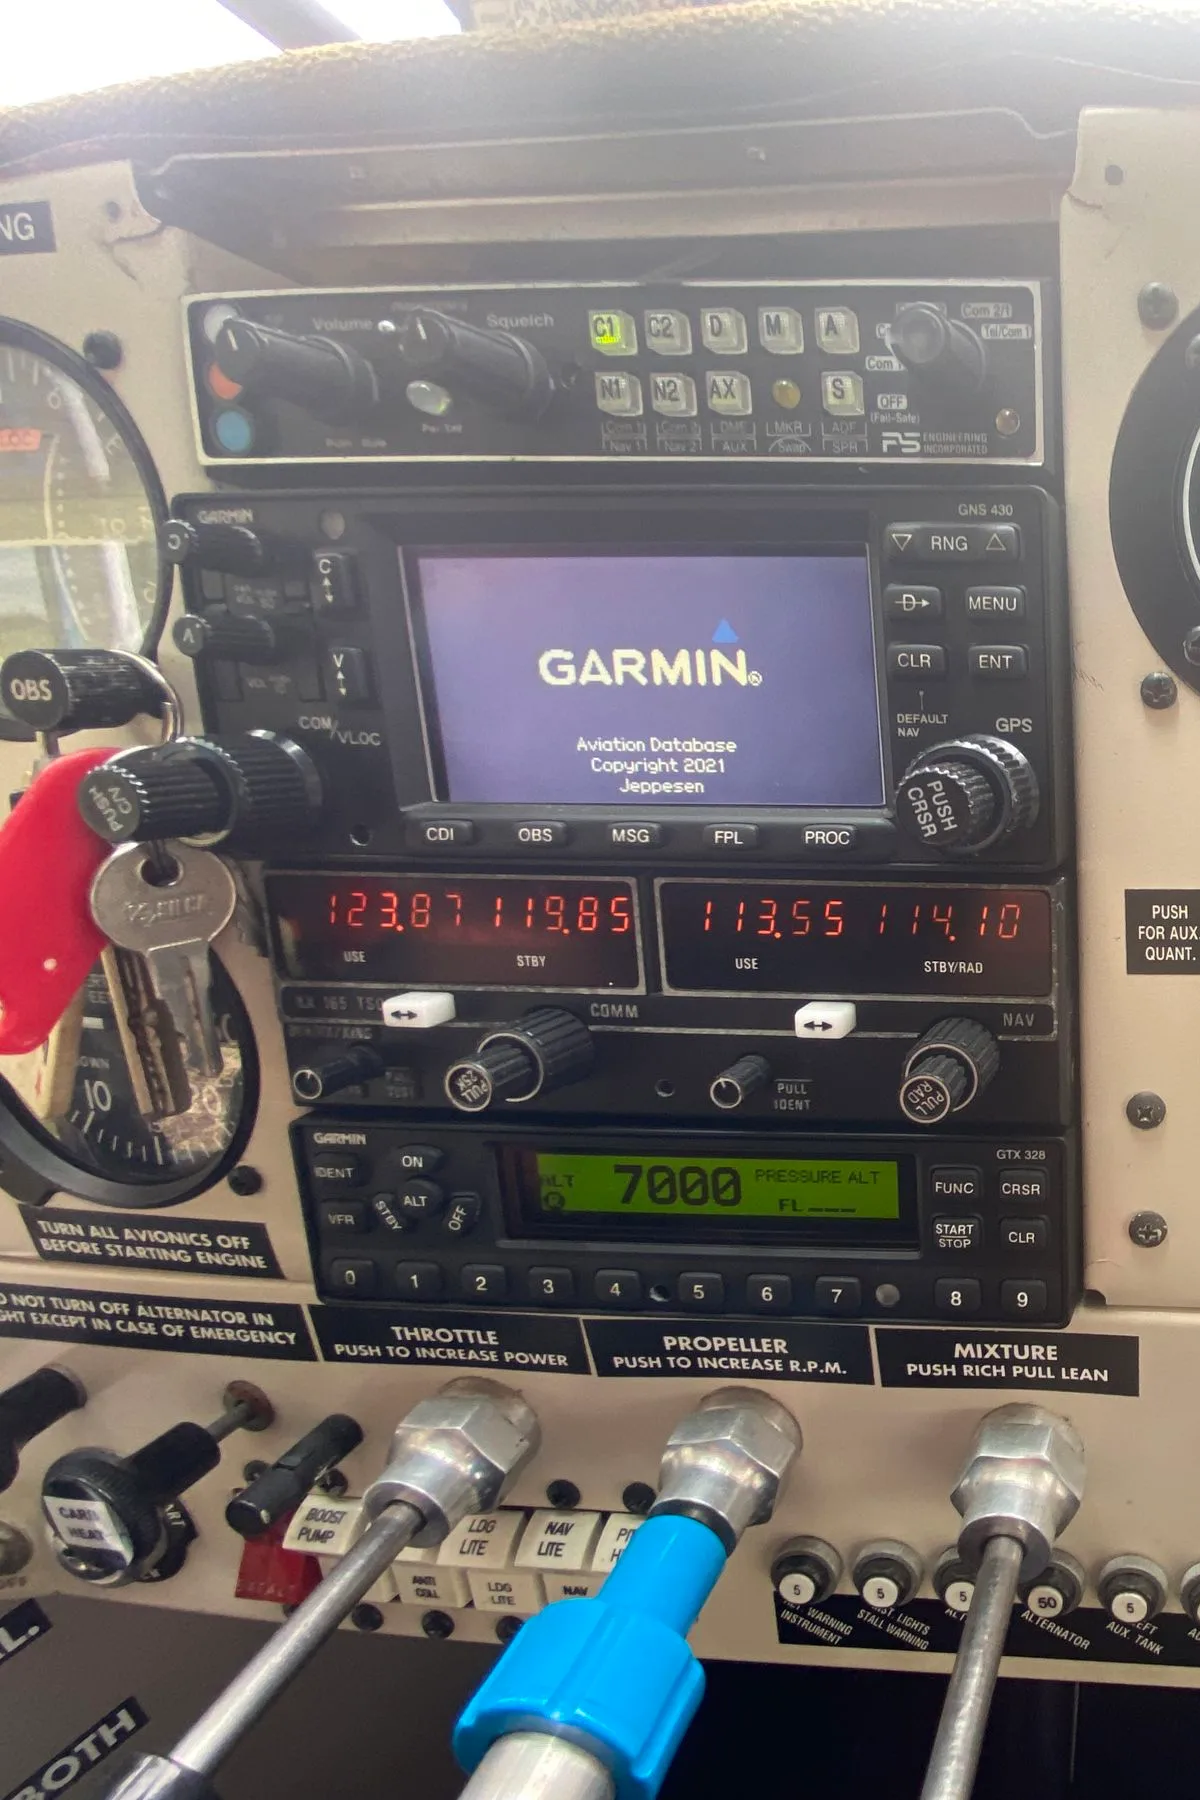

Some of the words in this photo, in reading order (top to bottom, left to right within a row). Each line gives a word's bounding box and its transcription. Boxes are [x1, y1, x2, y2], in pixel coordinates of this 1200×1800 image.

[312, 318, 373, 331] Volume
[487, 314, 554, 329] Squelch
[594, 317, 615, 337] C1
[648, 319, 674, 338] C2
[197, 509, 253, 524] GARMIN
[958, 504, 987, 516] GNS
[991, 504, 1013, 516] 430
[931, 536, 968, 551] RNG
[969, 596, 1017, 611] MENU
[898, 654, 931, 668] CLR
[979, 655, 1012, 669] ENT
[10, 678, 52, 701] OBS
[897, 714, 948, 724] DEFAULT
[996, 718, 1033, 732] GPS
[299, 716, 381, 746] COM/VLOC
[898, 727, 919, 737] NAV
[577, 736, 645, 753] Aviation
[650, 738, 737, 753] Database
[591, 757, 678, 775] Copyright
[684, 759, 725, 773] 2021
[620, 779, 704, 795] Jeppesen
[908, 787, 937, 837] CRSR
[927, 780, 958, 831] PUSH
[427, 827, 454, 842] CDI
[518, 828, 552, 842] OBS
[612, 828, 649, 843] MSG
[715, 830, 743, 845] FPL
[805, 831, 850, 845] PROC
[330, 892, 461, 931] 123.87
[495, 895, 631, 934] 119.85
[1152, 905, 1188, 919] PUSH
[704, 900, 844, 938] 113.55
[879, 903, 1020, 942] 114.10
[1138, 926, 1165, 939] FOR
[344, 951, 366, 963] USE
[517, 955, 545, 967] STBY
[1145, 947, 1196, 961] QUANT.
[735, 958, 758, 969] USE
[924, 960, 983, 973] STBY/RAD
[314, 1133, 366, 1145] GARMIN
[315, 1168, 355, 1179] IDENT
[613, 1163, 742, 1207] 7000
[935, 1182, 974, 1194] FUNC
[1002, 1182, 1041, 1195] CRSR
[38, 1220, 84, 1237] TURN
[90, 1225, 118, 1240] ALL
[124, 1228, 212, 1248] AVIONICS
[216, 1236, 250, 1250] OFF
[936, 1224, 974, 1236] START
[1008, 1232, 1035, 1243] CLR
[939, 1238, 971, 1248] STOP
[41, 1238, 101, 1255] BEFORE
[105, 1243, 191, 1263] STARTING
[196, 1251, 267, 1269] ENGINE
[13, 1295, 46, 1309] NOT
[50, 1297, 95, 1313] TURN
[100, 1301, 131, 1316] OFF
[138, 1303, 247, 1324] ALTERNATOR
[252, 1312, 274, 1326] IN
[391, 1326, 499, 1345] THROTTLE
[664, 1335, 788, 1354] PROPELLER
[954, 1343, 1058, 1361] MIXTURE
[335, 1345, 381, 1358] PUSH
[386, 1348, 410, 1358] TO
[416, 1348, 499, 1362] INCREASE
[504, 1353, 568, 1367] POWER
[907, 1364, 957, 1377] PUSH
[963, 1365, 1006, 1378] RICH
[1013, 1366, 1055, 1379] PULL
[1061, 1368, 1108, 1382] LEAN
[306, 1508, 346, 1524] BOOST
[297, 1527, 335, 1543] PUMP
[545, 1522, 574, 1535] NAV
[459, 1541, 488, 1555] LITE
[538, 1542, 566, 1557] LITE
[781, 1610, 843, 1645] INSTRUMENT
[857, 1610, 884, 1629] STALL
[886, 1623, 930, 1650] WARNING
[1021, 1609, 1091, 1650] ALTERNATOR
